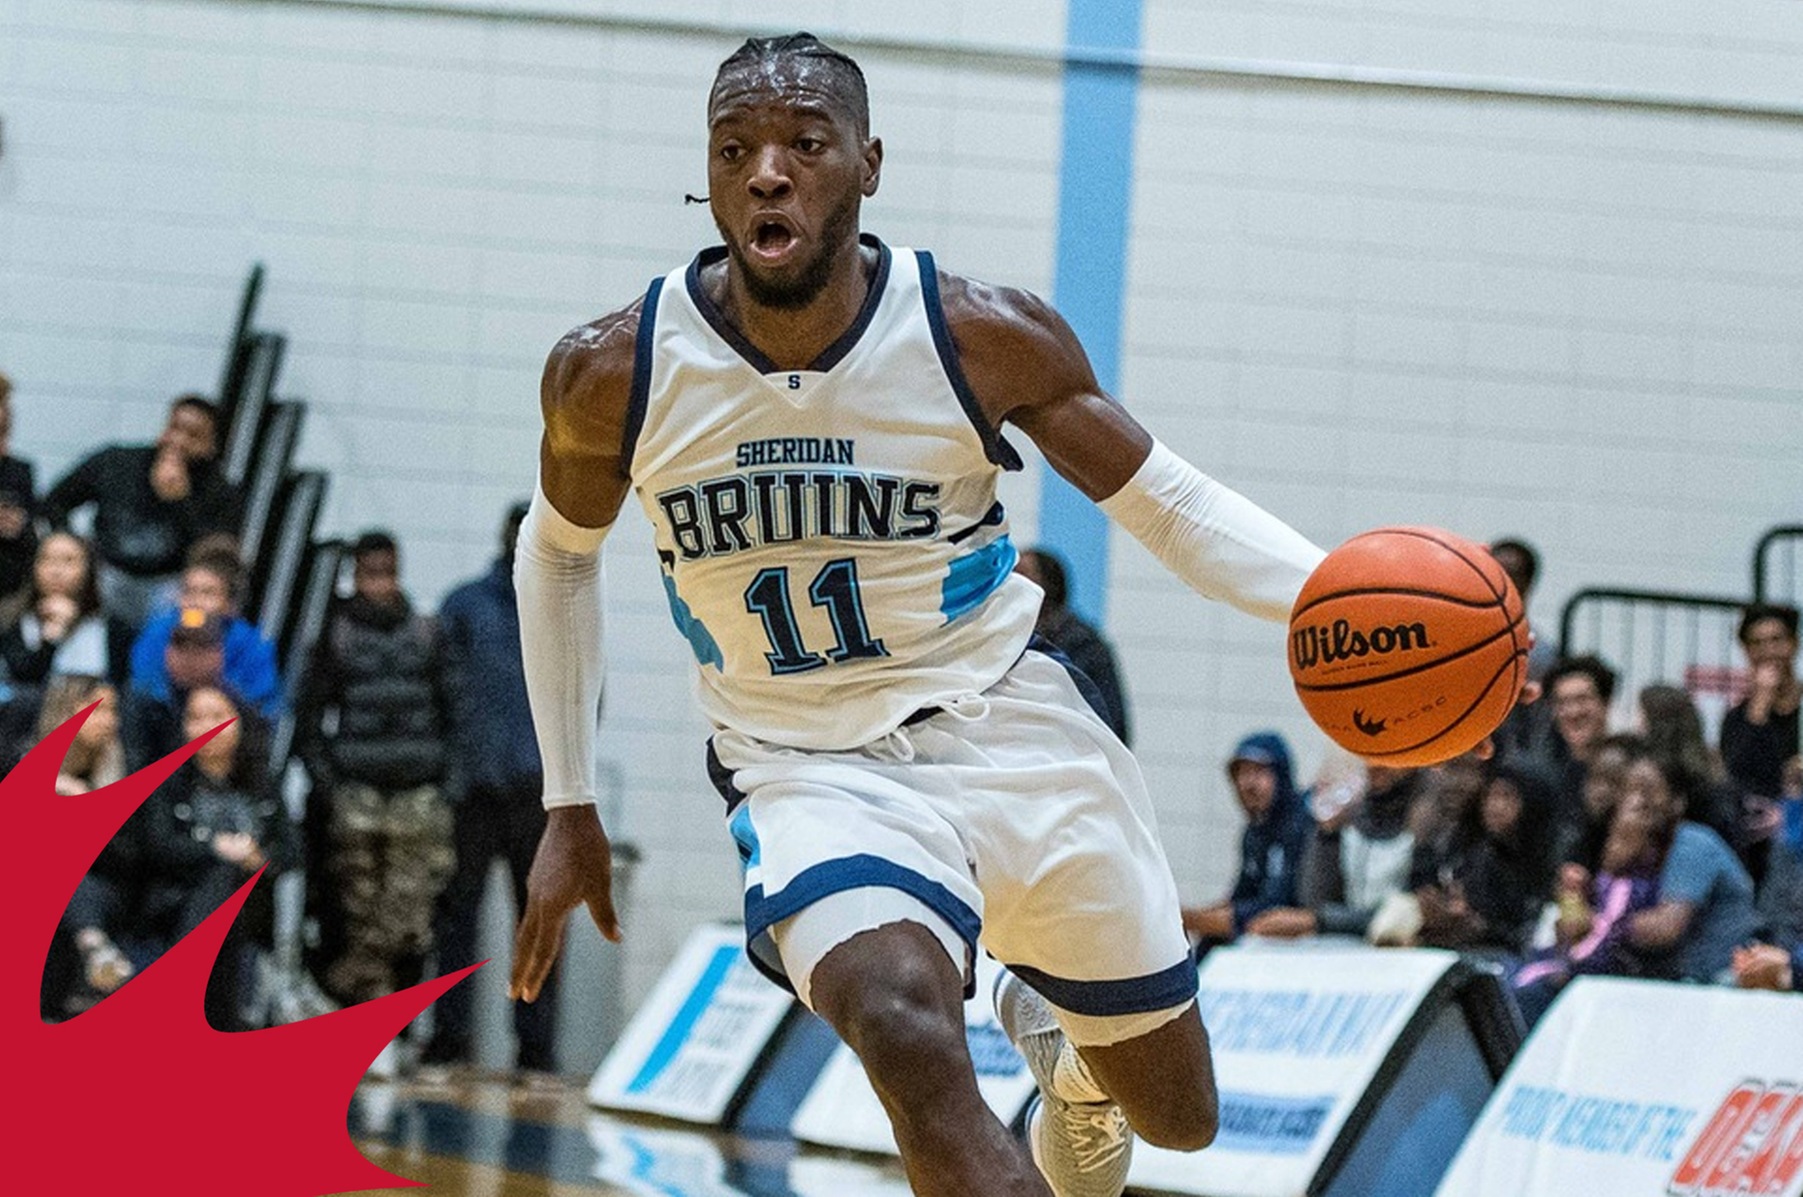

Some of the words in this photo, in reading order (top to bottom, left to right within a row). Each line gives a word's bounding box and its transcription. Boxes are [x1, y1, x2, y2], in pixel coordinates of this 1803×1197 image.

[787, 374, 801, 390] S
[736, 437, 855, 468] SHERIDAN
[656, 470, 944, 562] BRUINS
[743, 556, 892, 676] 11
[1293, 618, 1431, 671] Wilson
